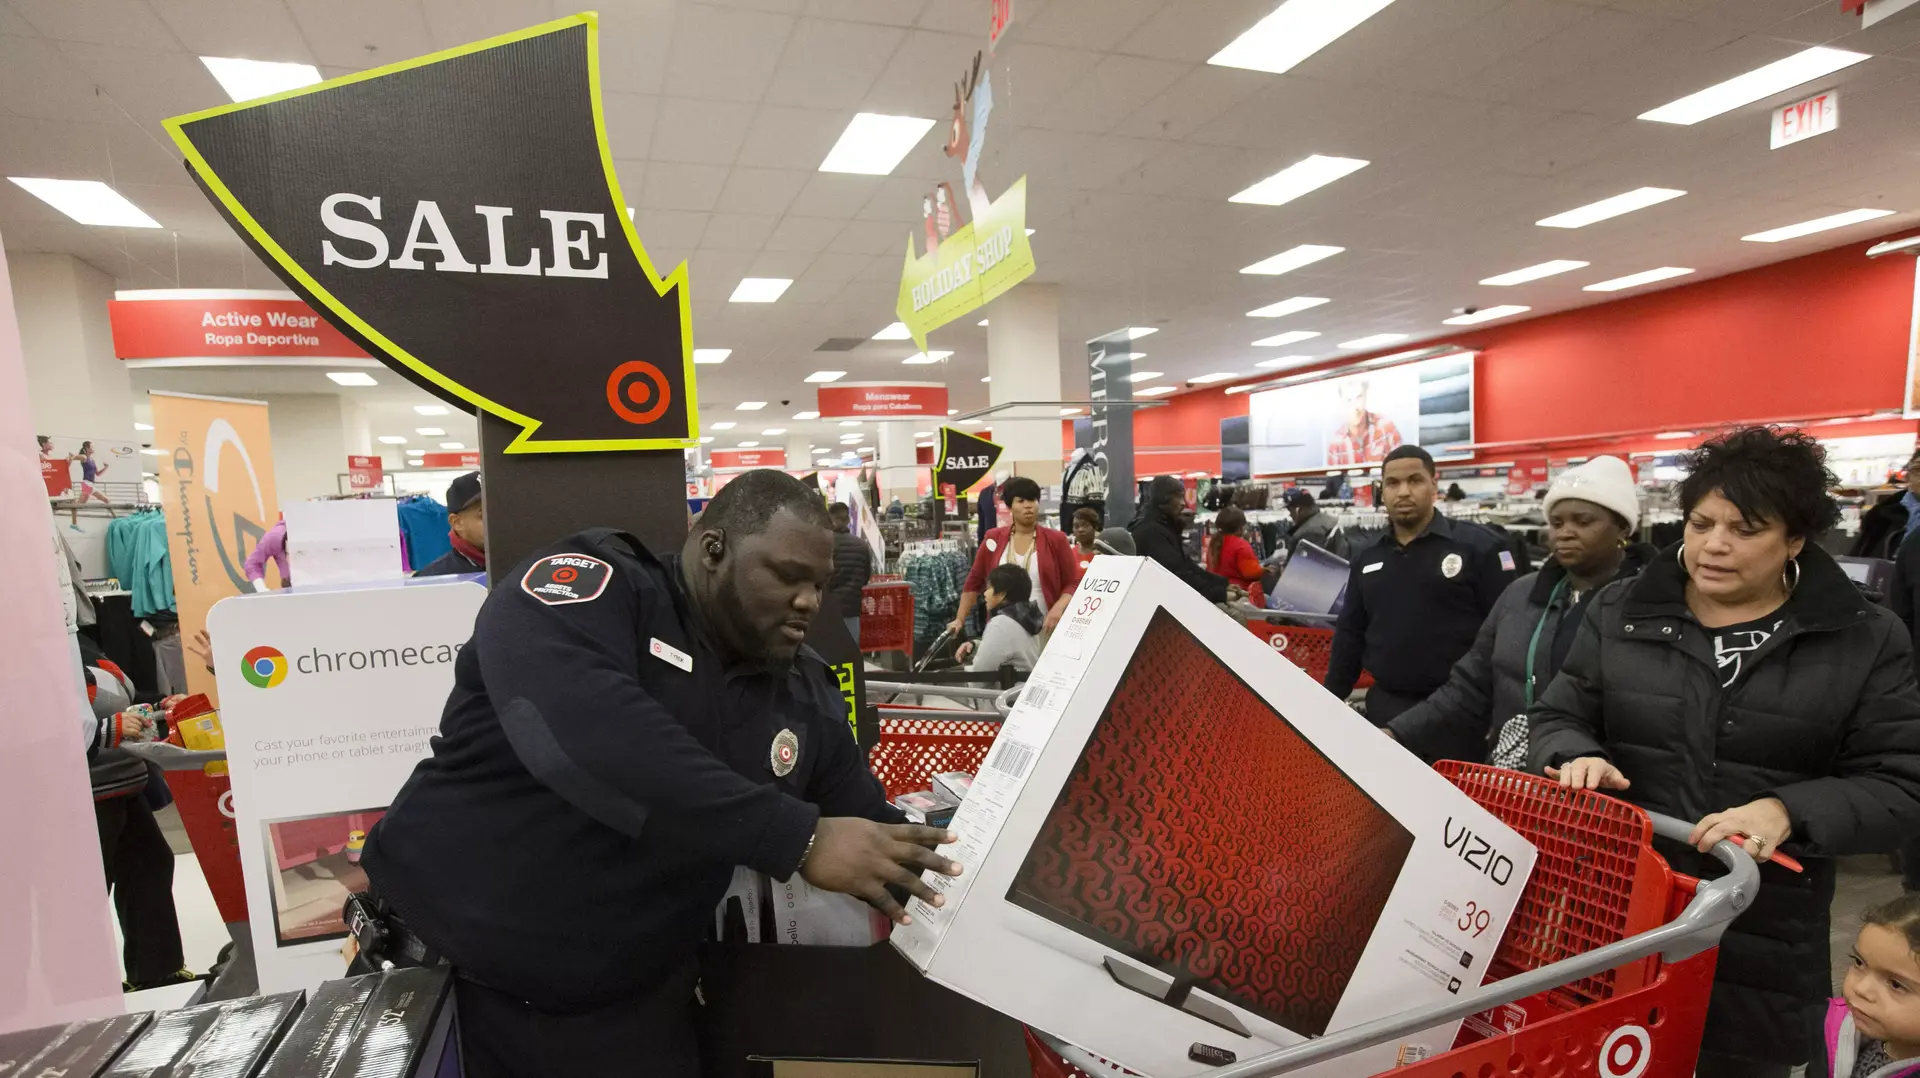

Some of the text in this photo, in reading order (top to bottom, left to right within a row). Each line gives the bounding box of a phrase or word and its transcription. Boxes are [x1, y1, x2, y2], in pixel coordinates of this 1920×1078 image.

[1782, 95, 1828, 139] EXIT
[320, 192, 609, 280] SALE
[912, 224, 1012, 313] HOLIDAY SHOP
[201, 312, 318, 328] Active Wear
[205, 333, 320, 347] Ropa Deportiva
[946, 455, 989, 470] SALE
[173, 447, 200, 586] Champion
[550, 557, 599, 569] TARGET
[533, 587, 579, 599] PROTECTION
[1083, 577, 1120, 593] VIZIO
[255, 739, 283, 751] Cast
[286, 737, 314, 754] your
[319, 733, 366, 746] favorite
[253, 754, 283, 768] your
[287, 749, 328, 766] phone
[332, 750, 345, 759] or
[349, 744, 384, 757] tablet
[1444, 817, 1513, 886] VIZIO
